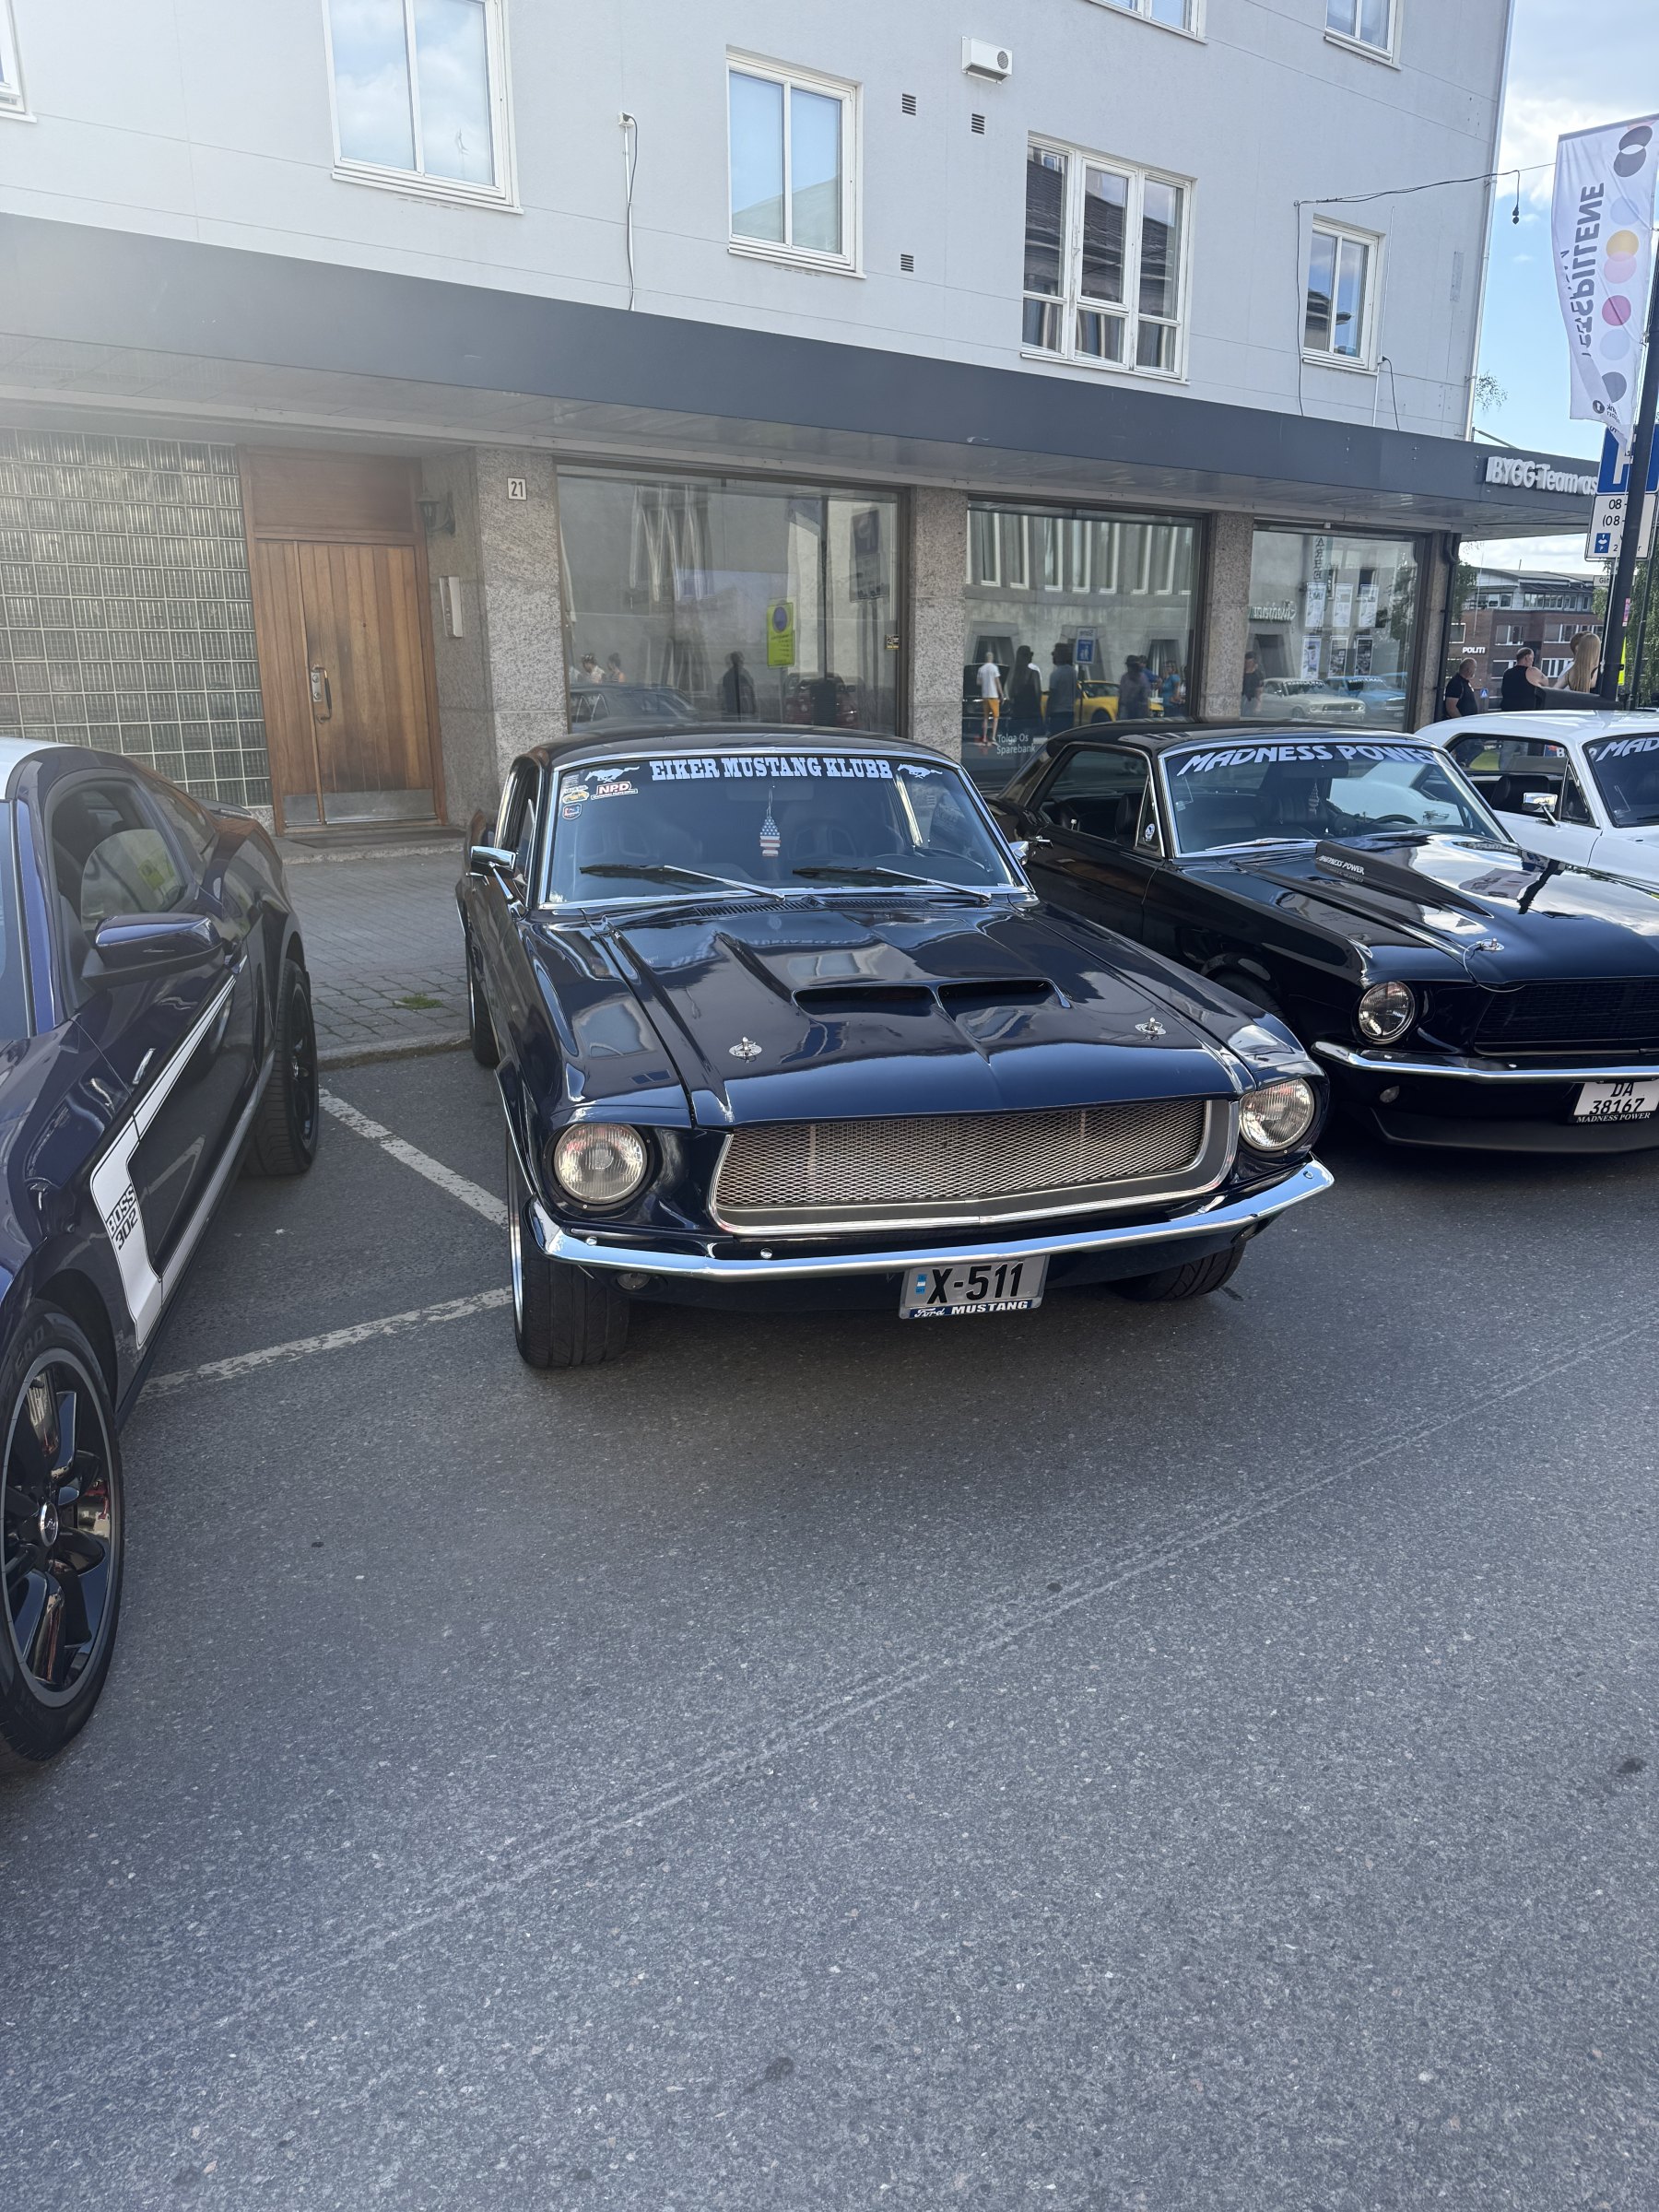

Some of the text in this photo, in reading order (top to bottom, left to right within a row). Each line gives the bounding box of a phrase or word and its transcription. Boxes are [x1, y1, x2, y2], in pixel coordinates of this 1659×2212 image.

[1487, 456, 1578, 493] BYGG-Team
[511, 480, 524, 498] 21
[1462, 646, 1486, 654] POLITI
[996, 743, 1036, 756] Sparebank
[649, 757, 893, 781] EIKER MUSTANG KLUBB
[1176, 745, 1334, 776] MADNESS
[1342, 862, 1365, 876] POWER
[1610, 1083, 1634, 1098] DA
[1589, 1098, 1645, 1115] 38167
[1576, 1112, 1651, 1124] MADNESS POWER
[106, 1185, 135, 1236] BOSS
[115, 1207, 138, 1251] 302
[926, 1263, 1024, 1305] X-511
[913, 1300, 1029, 1318] Ford MUSTANG
